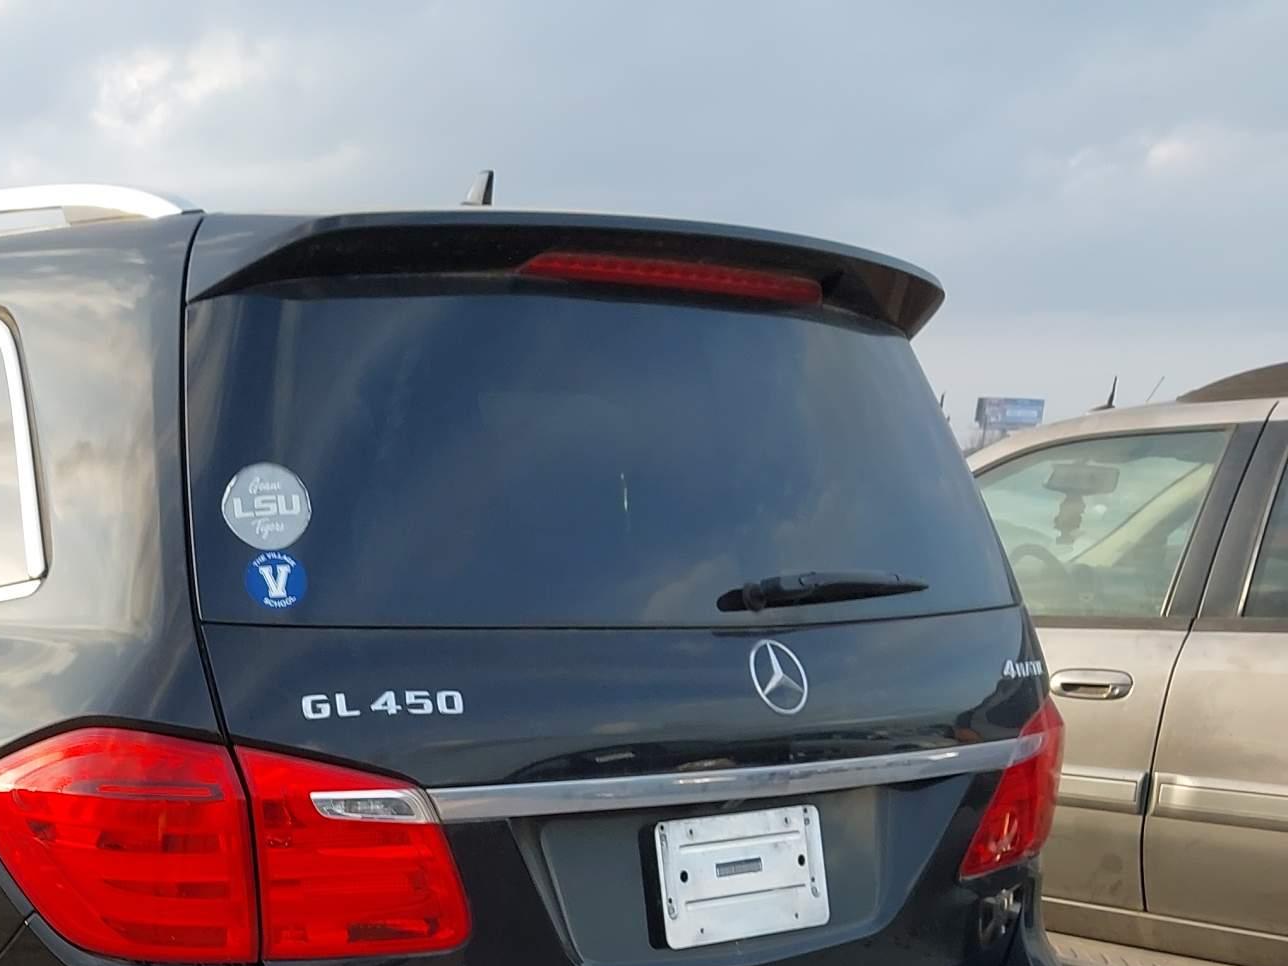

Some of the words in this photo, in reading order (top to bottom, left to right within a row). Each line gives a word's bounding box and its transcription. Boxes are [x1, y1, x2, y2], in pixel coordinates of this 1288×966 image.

[233, 494, 301, 519] LSU
[258, 564, 291, 599] V
[301, 692, 361, 720] GL
[370, 689, 464, 716] 450
